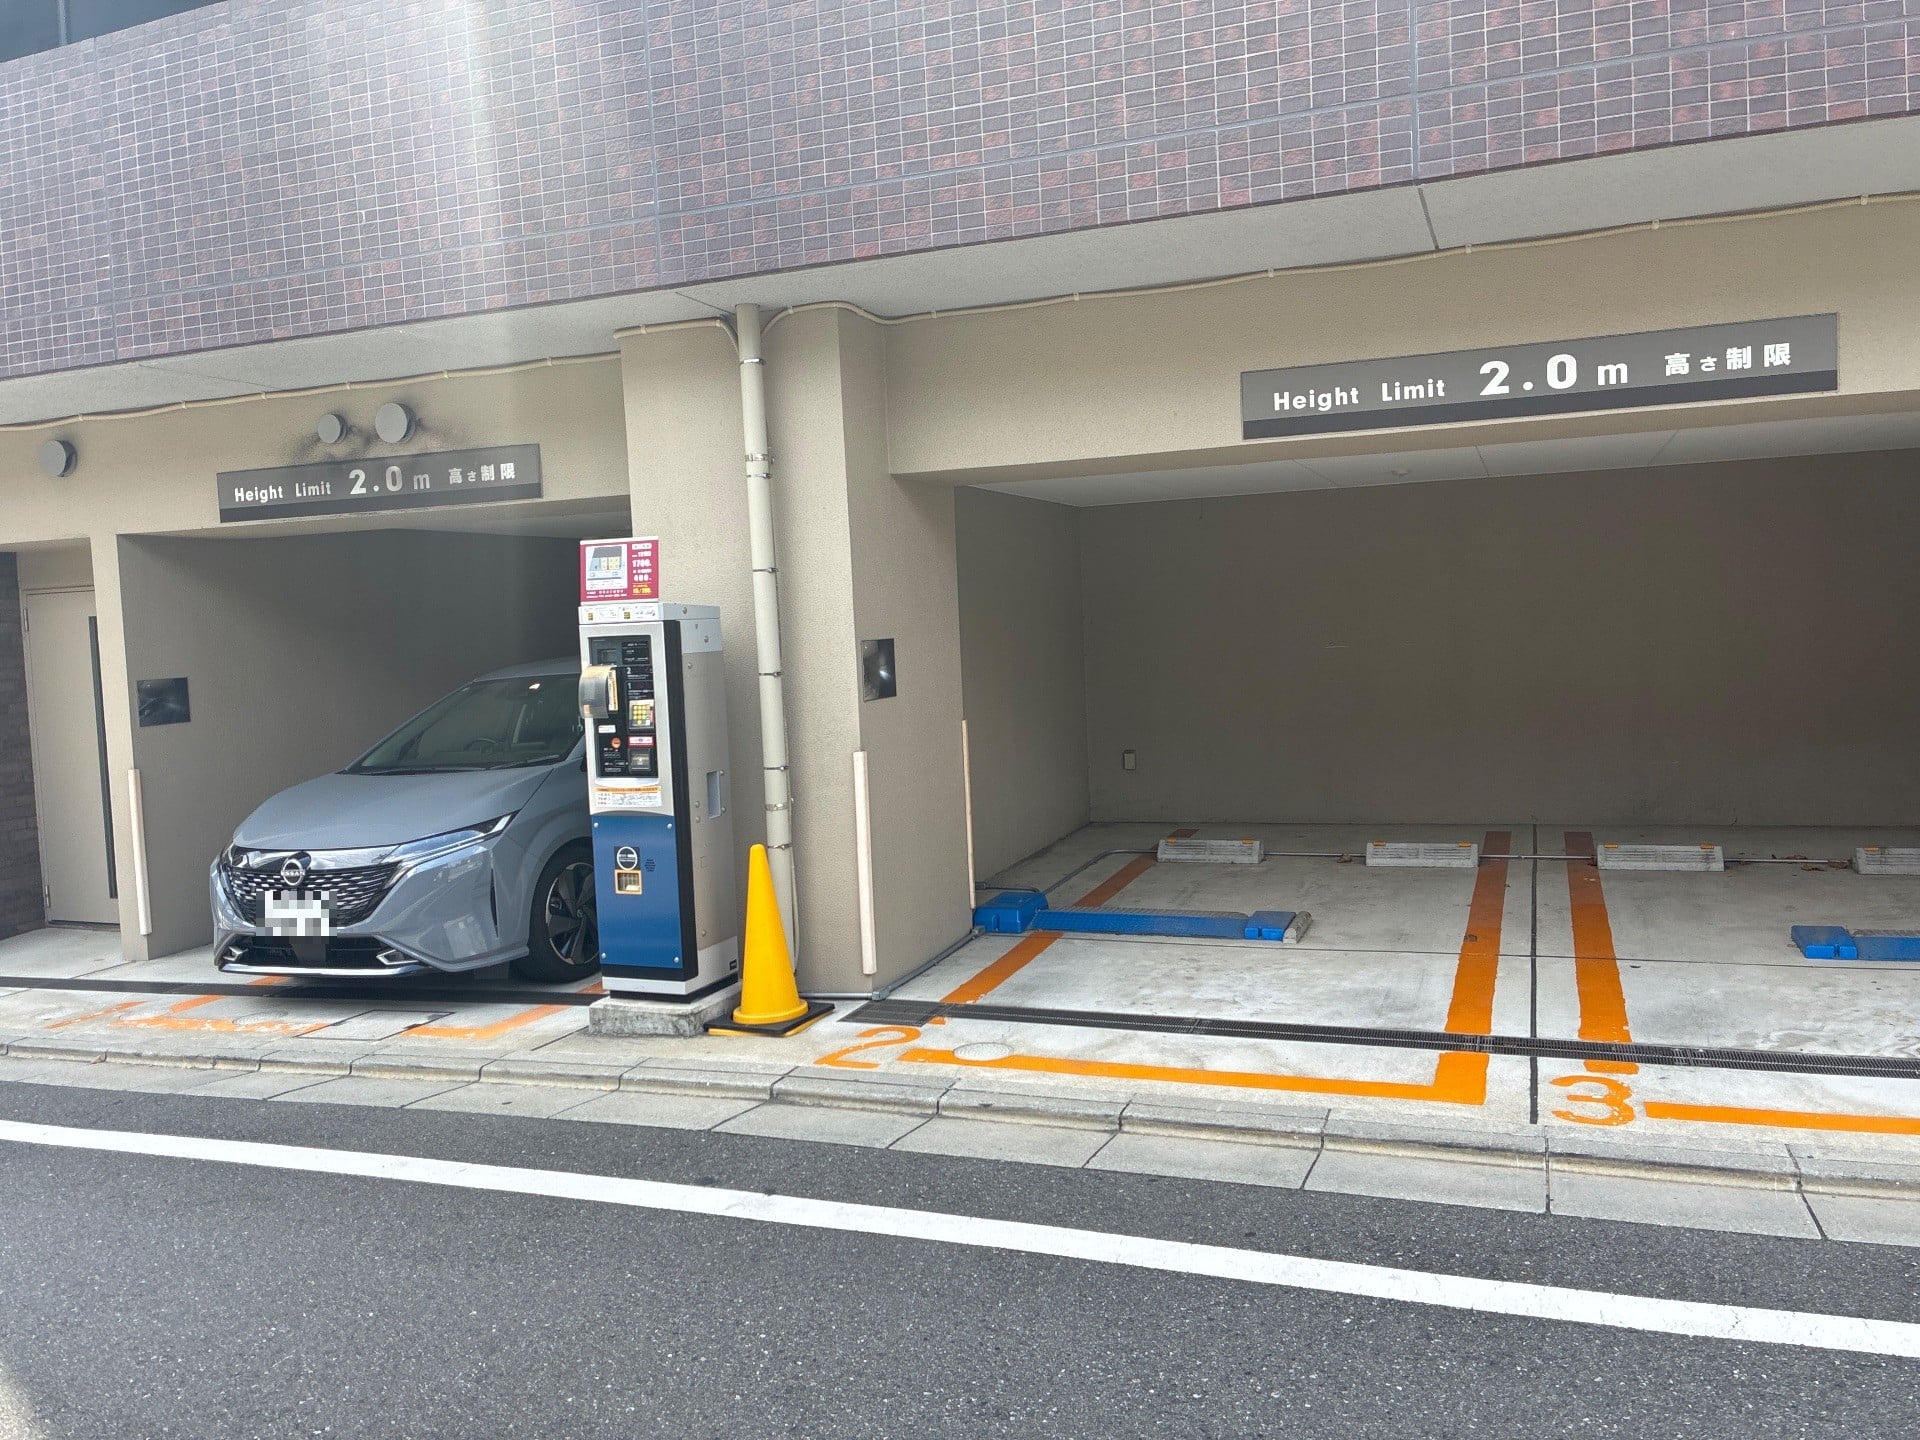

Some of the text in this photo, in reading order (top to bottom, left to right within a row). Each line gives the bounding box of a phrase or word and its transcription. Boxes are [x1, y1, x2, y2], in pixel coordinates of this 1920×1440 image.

[1273, 343, 1791, 412] Height Limit 2.0 m 高さ制限
[234, 462, 515, 503] Height Limit 2.0 m 高さ制限
[813, 1026, 922, 1070] 2
[1548, 1075, 1636, 1127] 3
